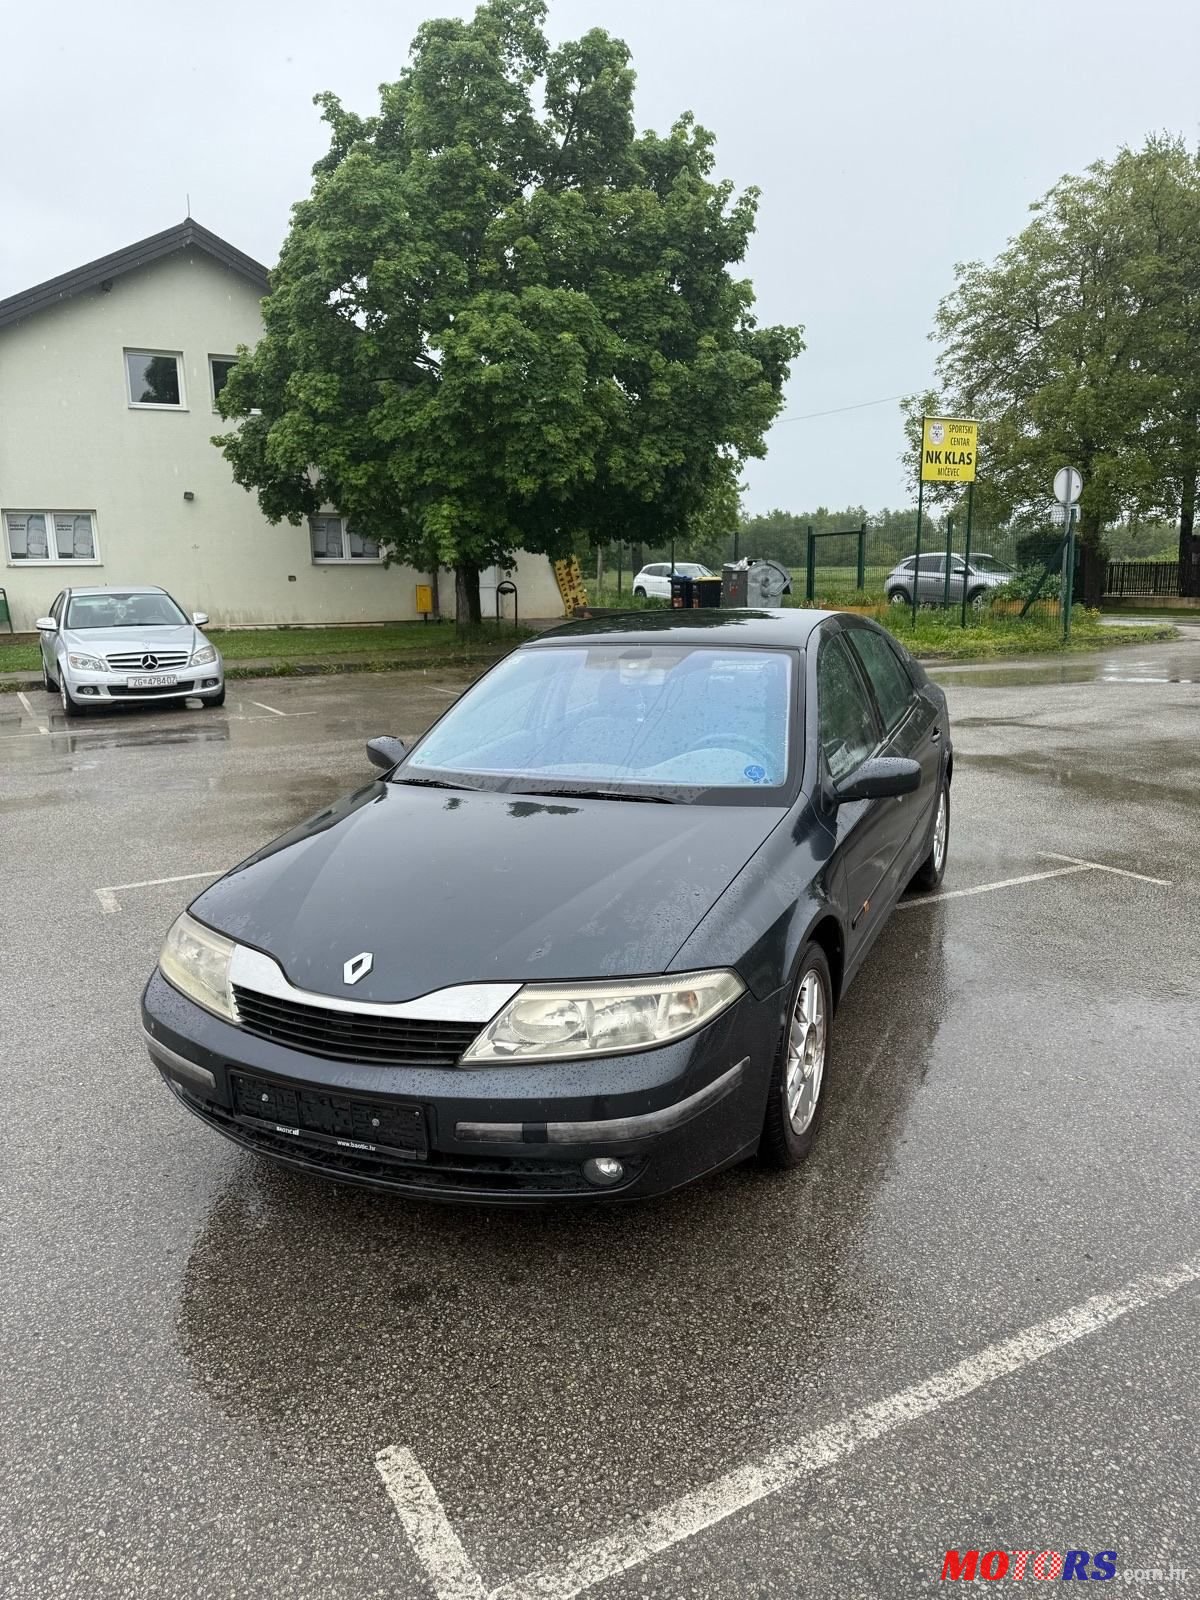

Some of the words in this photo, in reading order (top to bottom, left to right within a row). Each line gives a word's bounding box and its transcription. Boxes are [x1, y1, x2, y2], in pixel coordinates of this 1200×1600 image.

[948, 424, 973, 434] SPORTSKI
[950, 437, 970, 447] CENTAR
[926, 450, 942, 464] NK
[945, 451, 973, 465] KLAS
[937, 466, 960, 477] MIČEVEC
[133, 678, 143, 686] ZG
[336, 1140, 376, 1151] www.baotic.hr
